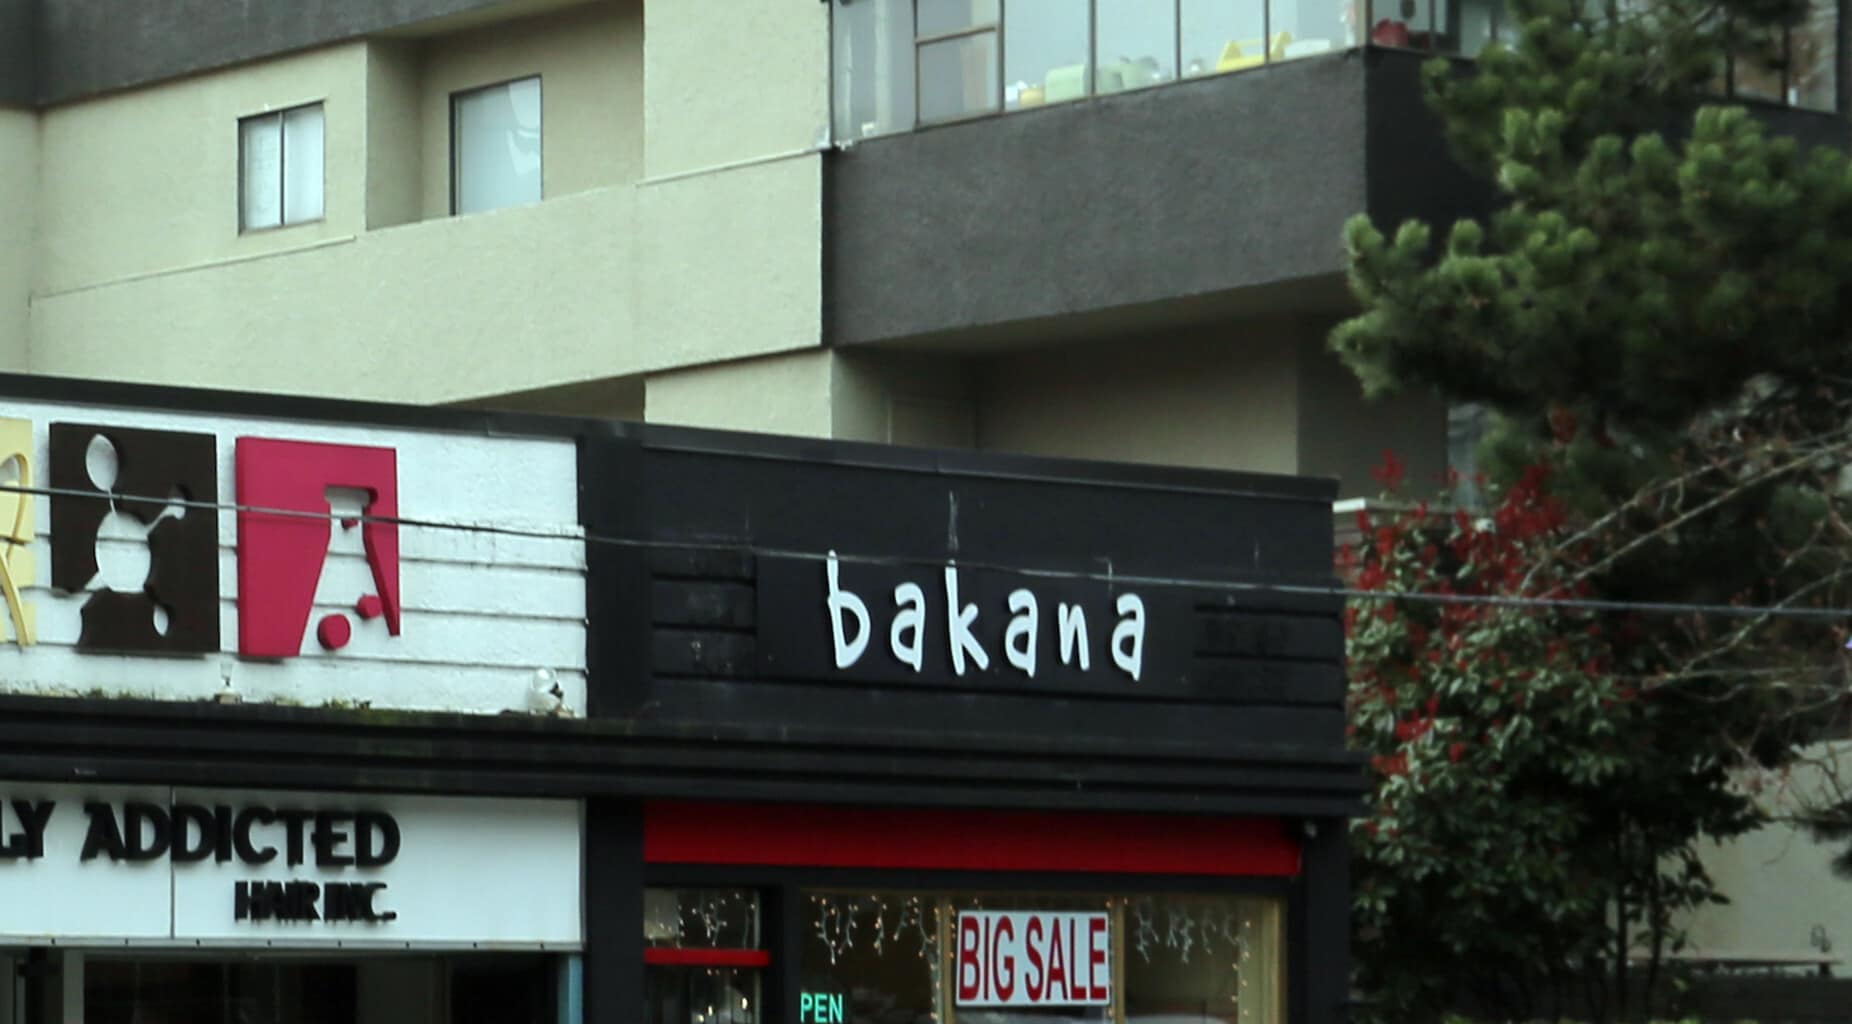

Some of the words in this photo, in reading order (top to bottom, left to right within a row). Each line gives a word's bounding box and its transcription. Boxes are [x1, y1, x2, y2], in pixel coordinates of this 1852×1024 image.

[827, 549, 1145, 681] bakana
[79, 800, 401, 868] ADDICTED
[234, 880, 320, 922] HAIR
[959, 915, 1014, 1002] BIG
[1024, 915, 1108, 1002] SALE
